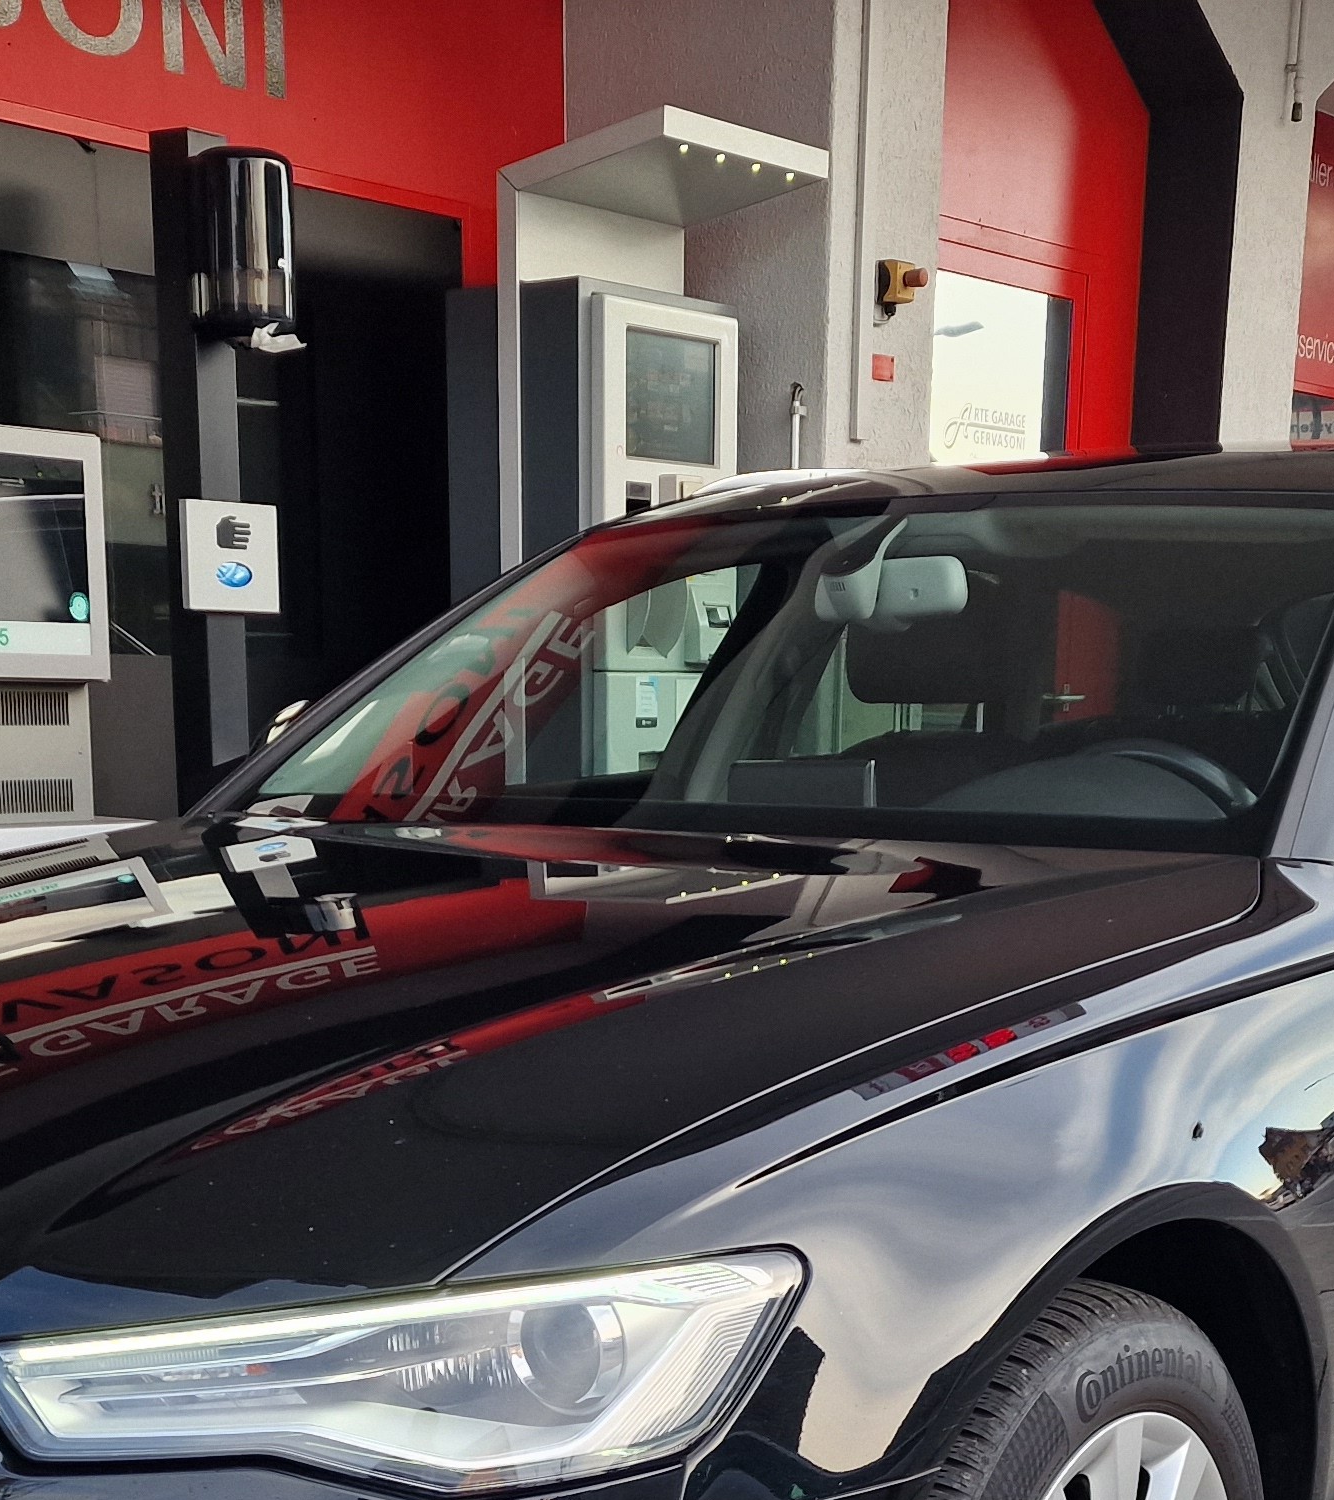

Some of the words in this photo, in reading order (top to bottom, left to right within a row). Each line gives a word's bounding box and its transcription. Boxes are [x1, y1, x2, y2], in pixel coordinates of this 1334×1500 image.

[991, 410, 1026, 429] GARAGE
[973, 429, 1026, 451] GERVASONI
[1075, 1344, 1203, 1424] Continental
